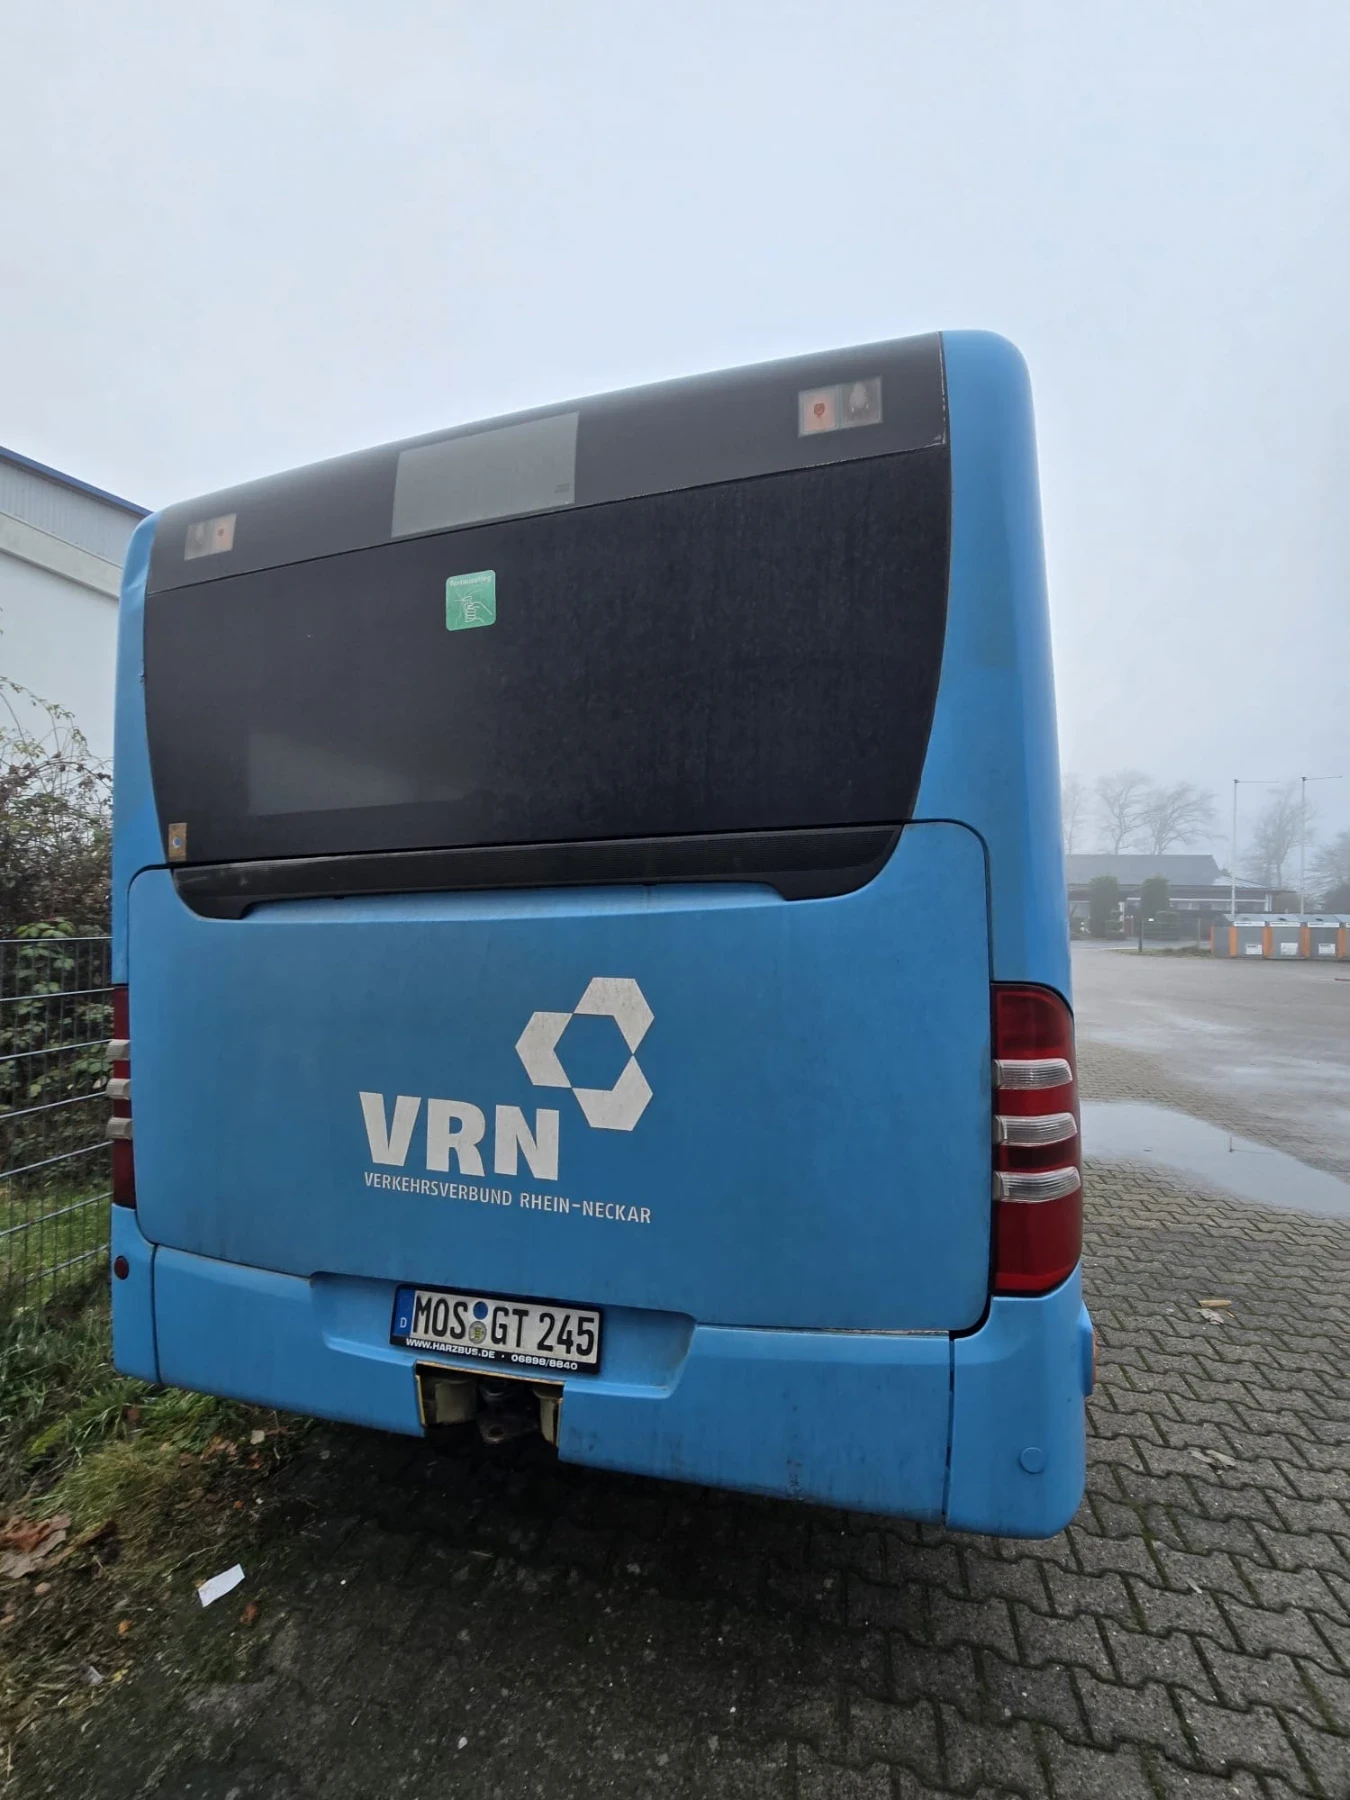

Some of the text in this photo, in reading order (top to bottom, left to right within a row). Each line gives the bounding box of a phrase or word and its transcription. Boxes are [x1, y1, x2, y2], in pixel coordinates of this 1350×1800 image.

[359, 1091, 560, 1181] VRN
[364, 1171, 651, 1224] VERKEHRSVERBUND RHEIN-NECKAR
[400, 1317, 407, 1328] D
[405, 1337, 496, 1360] WWW.HARZBUS.DE
[412, 1295, 595, 1357] MOS GT 245
